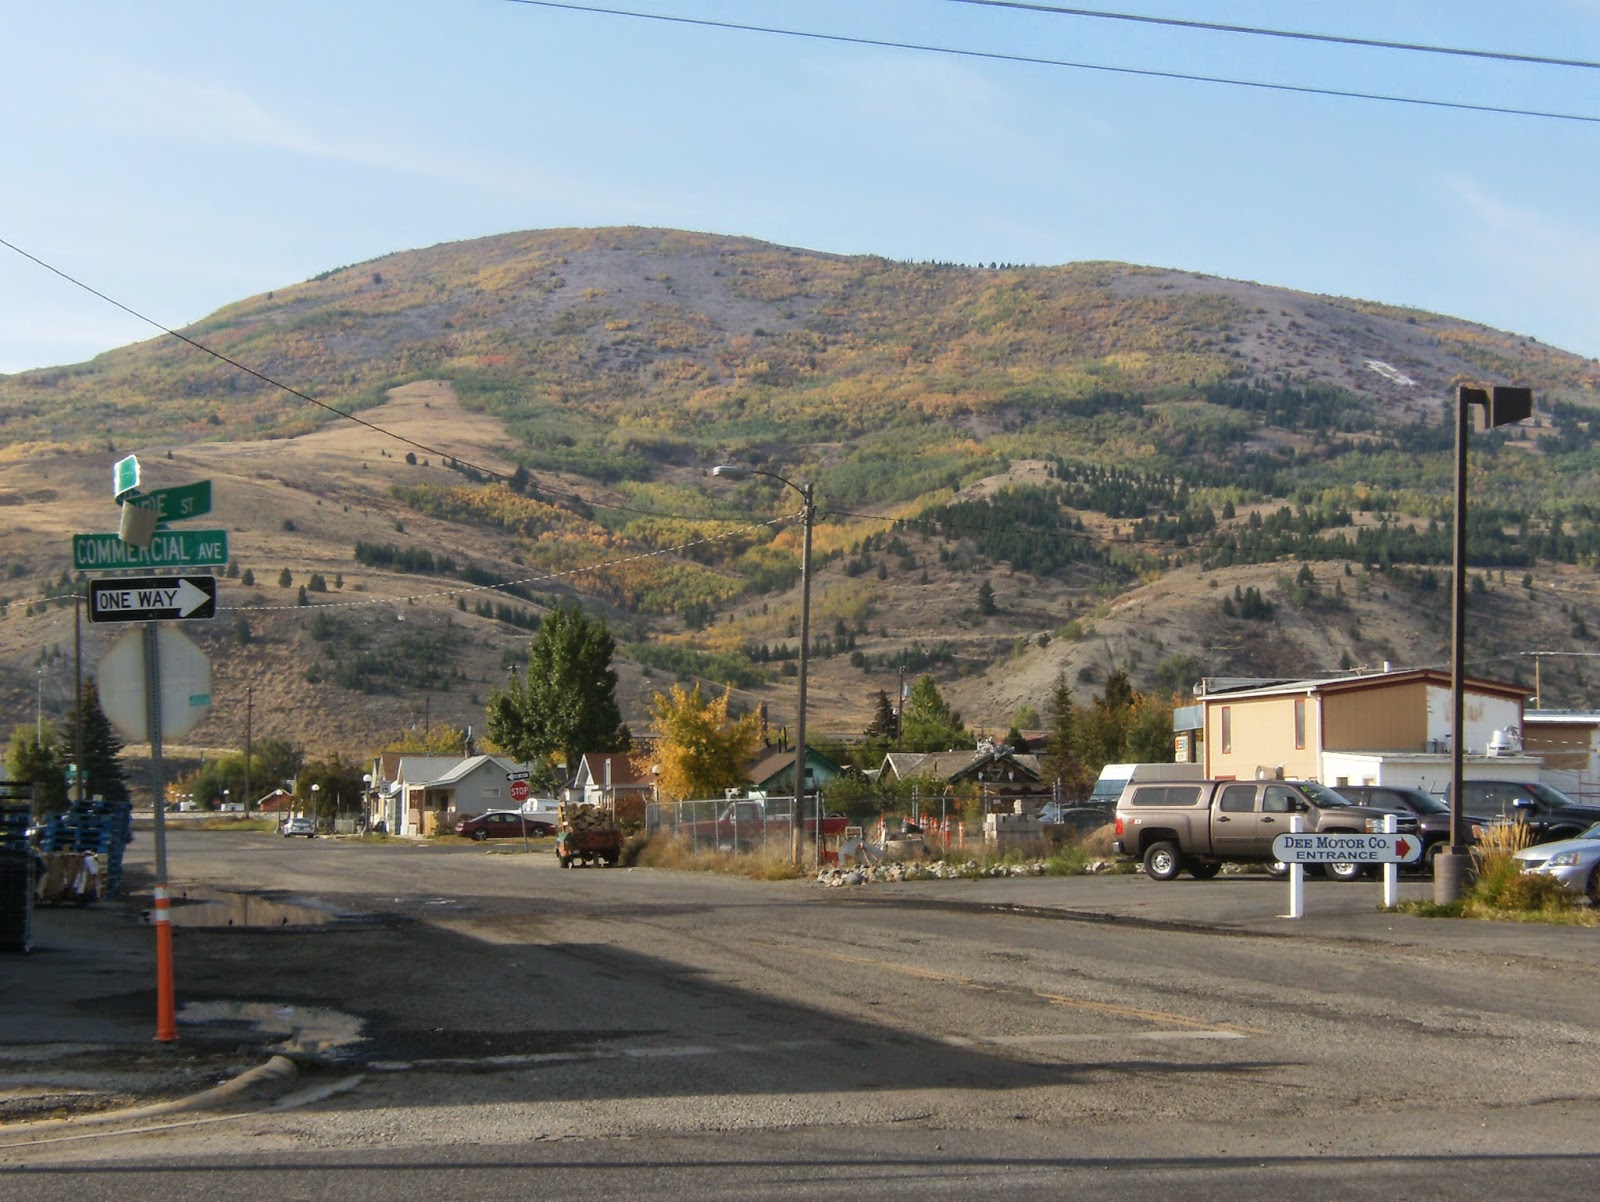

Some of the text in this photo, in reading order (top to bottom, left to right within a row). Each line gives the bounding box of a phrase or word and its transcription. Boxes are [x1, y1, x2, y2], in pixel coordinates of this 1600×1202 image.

[181, 497, 194, 515] ST
[77, 536, 222, 564] COMMERCIAL AVE
[100, 590, 178, 609] ONE WAY
[511, 787, 529, 796] STOP
[1284, 836, 1390, 849] DEE MOTOR CO.
[1296, 851, 1378, 860] ENTRANCE
